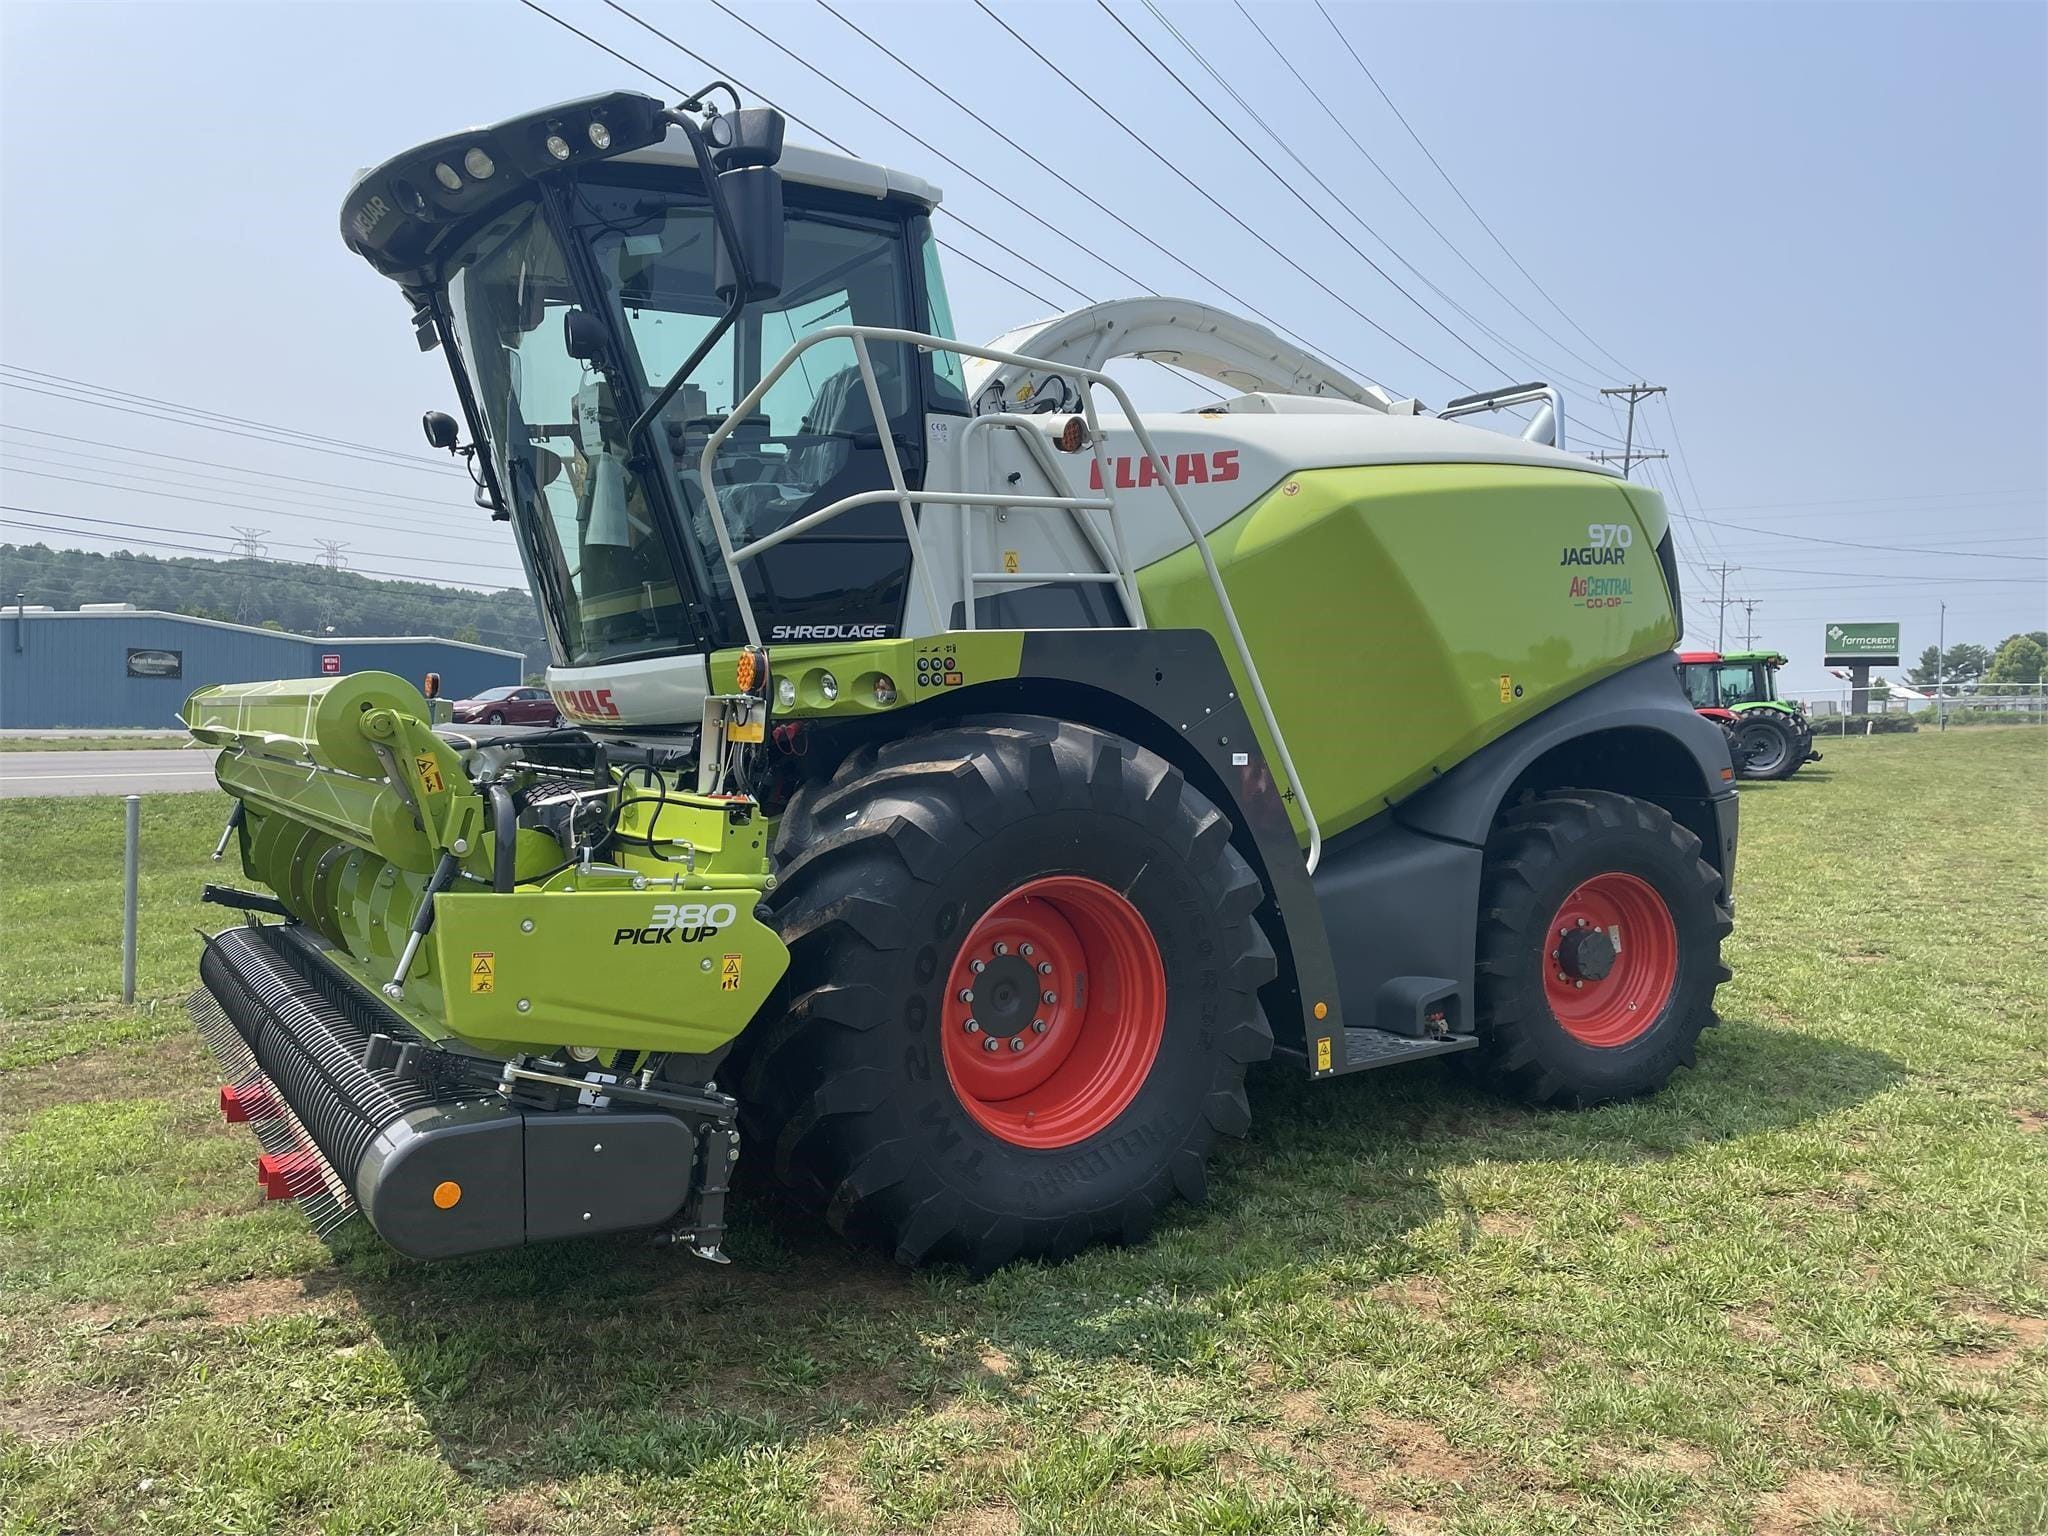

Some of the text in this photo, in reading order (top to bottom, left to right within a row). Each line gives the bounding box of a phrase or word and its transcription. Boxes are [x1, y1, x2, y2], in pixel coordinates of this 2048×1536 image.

[353, 196, 391, 241] JAGUAR
[1588, 524, 1632, 548] 970
[1560, 547, 1625, 566] JAGUAR
[772, 625, 887, 639] SHREDLAGE
[649, 904, 737, 929] 380
[613, 926, 718, 946] PICK UP
